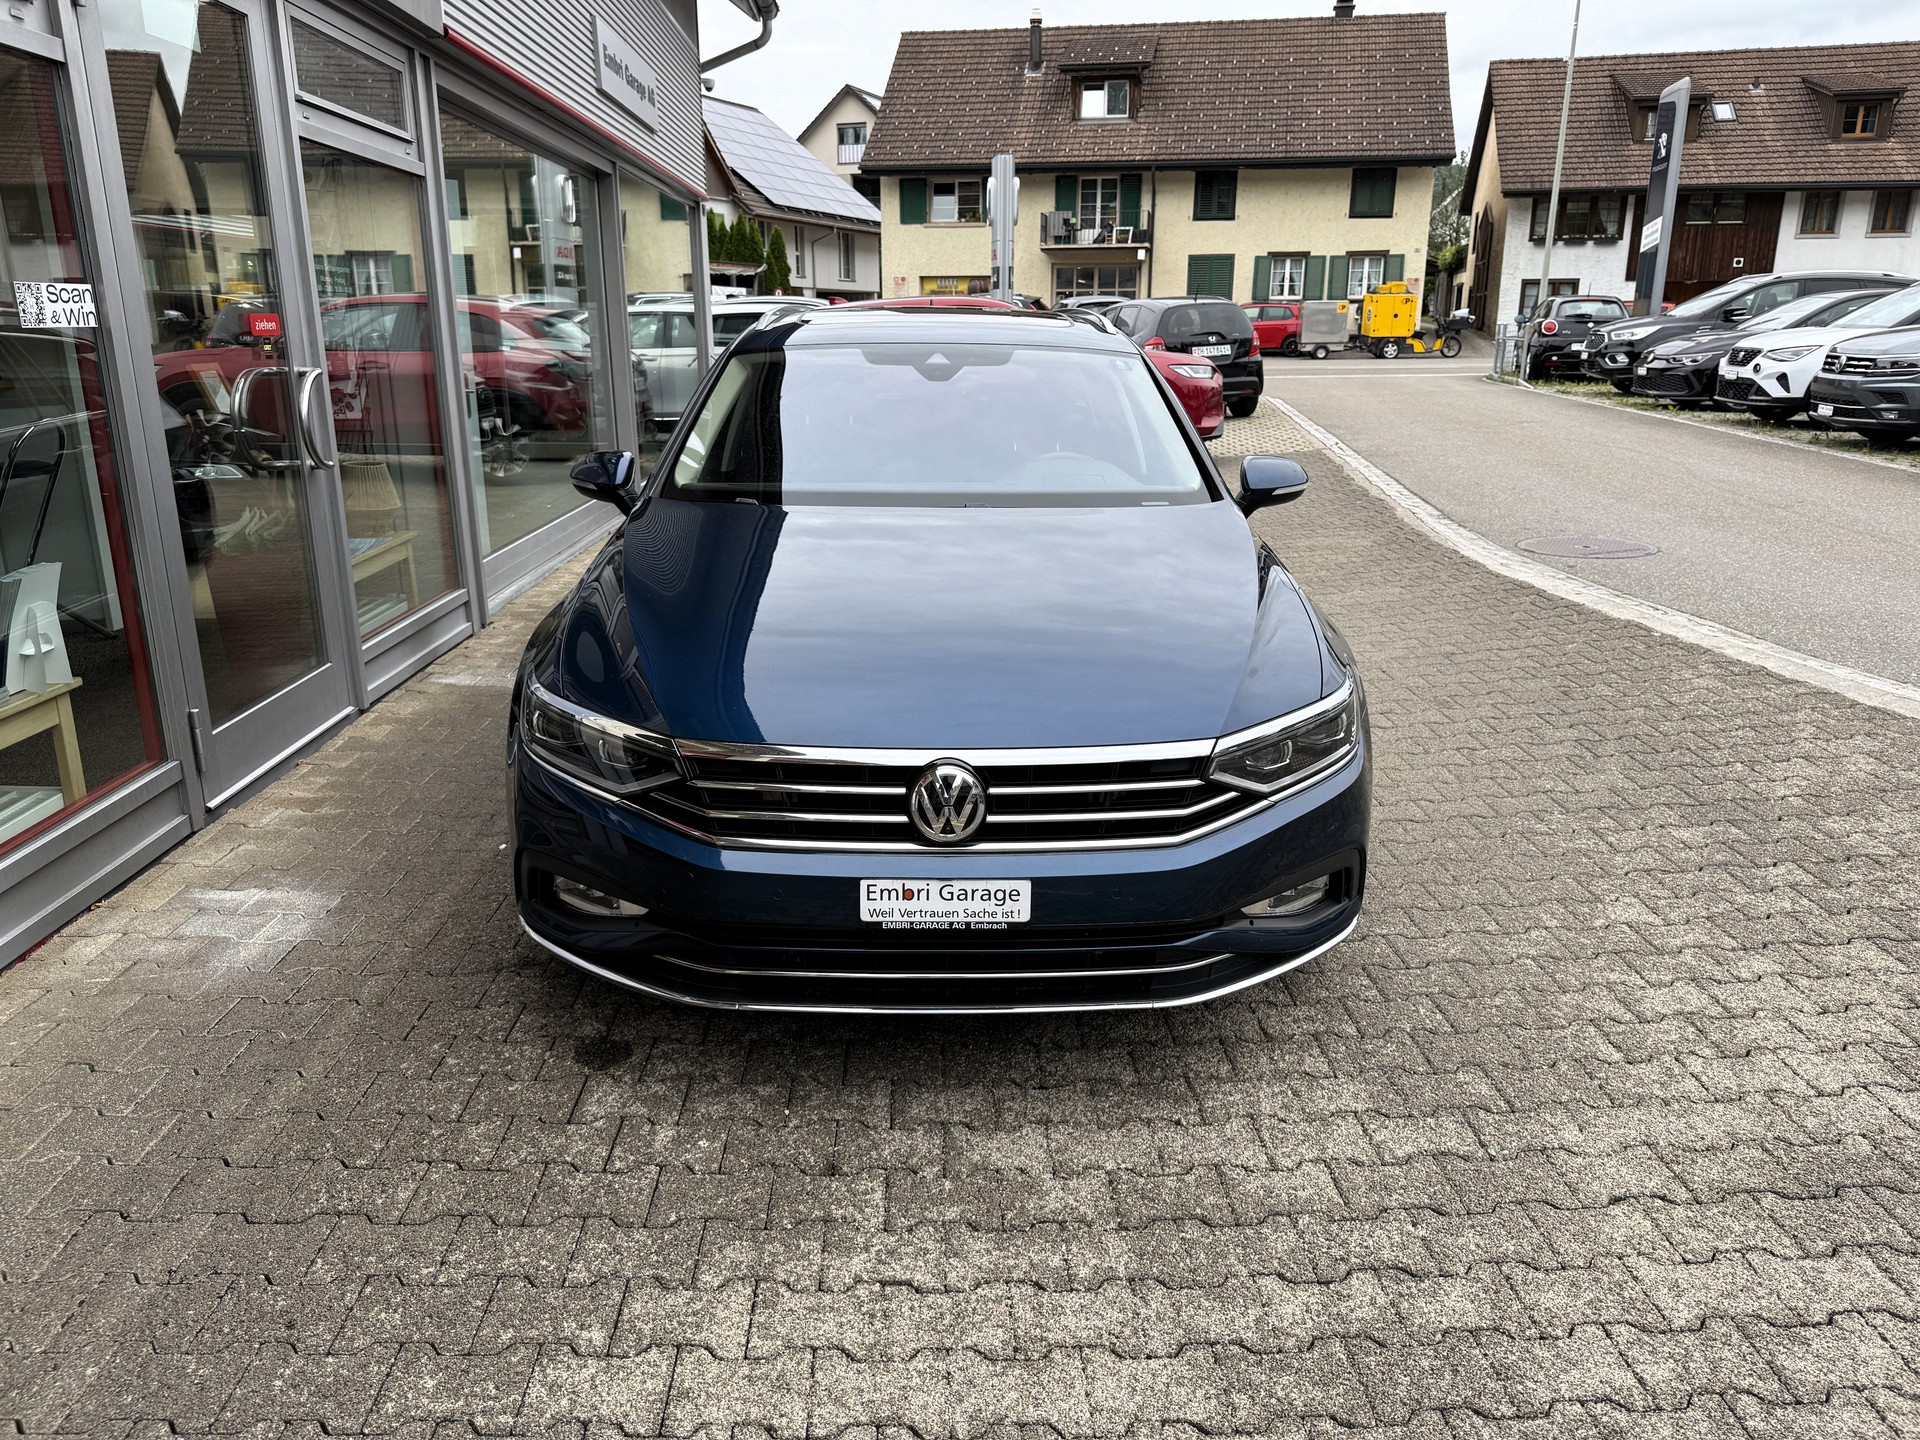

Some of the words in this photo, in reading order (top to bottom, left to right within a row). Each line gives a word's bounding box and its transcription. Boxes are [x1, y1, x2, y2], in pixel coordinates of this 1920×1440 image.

[603, 43, 624, 80] Embri
[625, 64, 646, 101] Garage
[46, 284, 94, 304] Scan
[51, 310, 62, 324] &
[62, 305, 98, 326] Win
[255, 318, 277, 330] ziehen
[866, 882, 930, 901] Embri
[939, 884, 1021, 906] Garage
[868, 907, 894, 918] Weil
[898, 908, 959, 918] Vertrauen
[963, 908, 998, 919] Sache
[882, 921, 950, 929] EMBRI-GARAGE
[952, 921, 966, 929] AG
[970, 921, 1008, 930] Embrach
